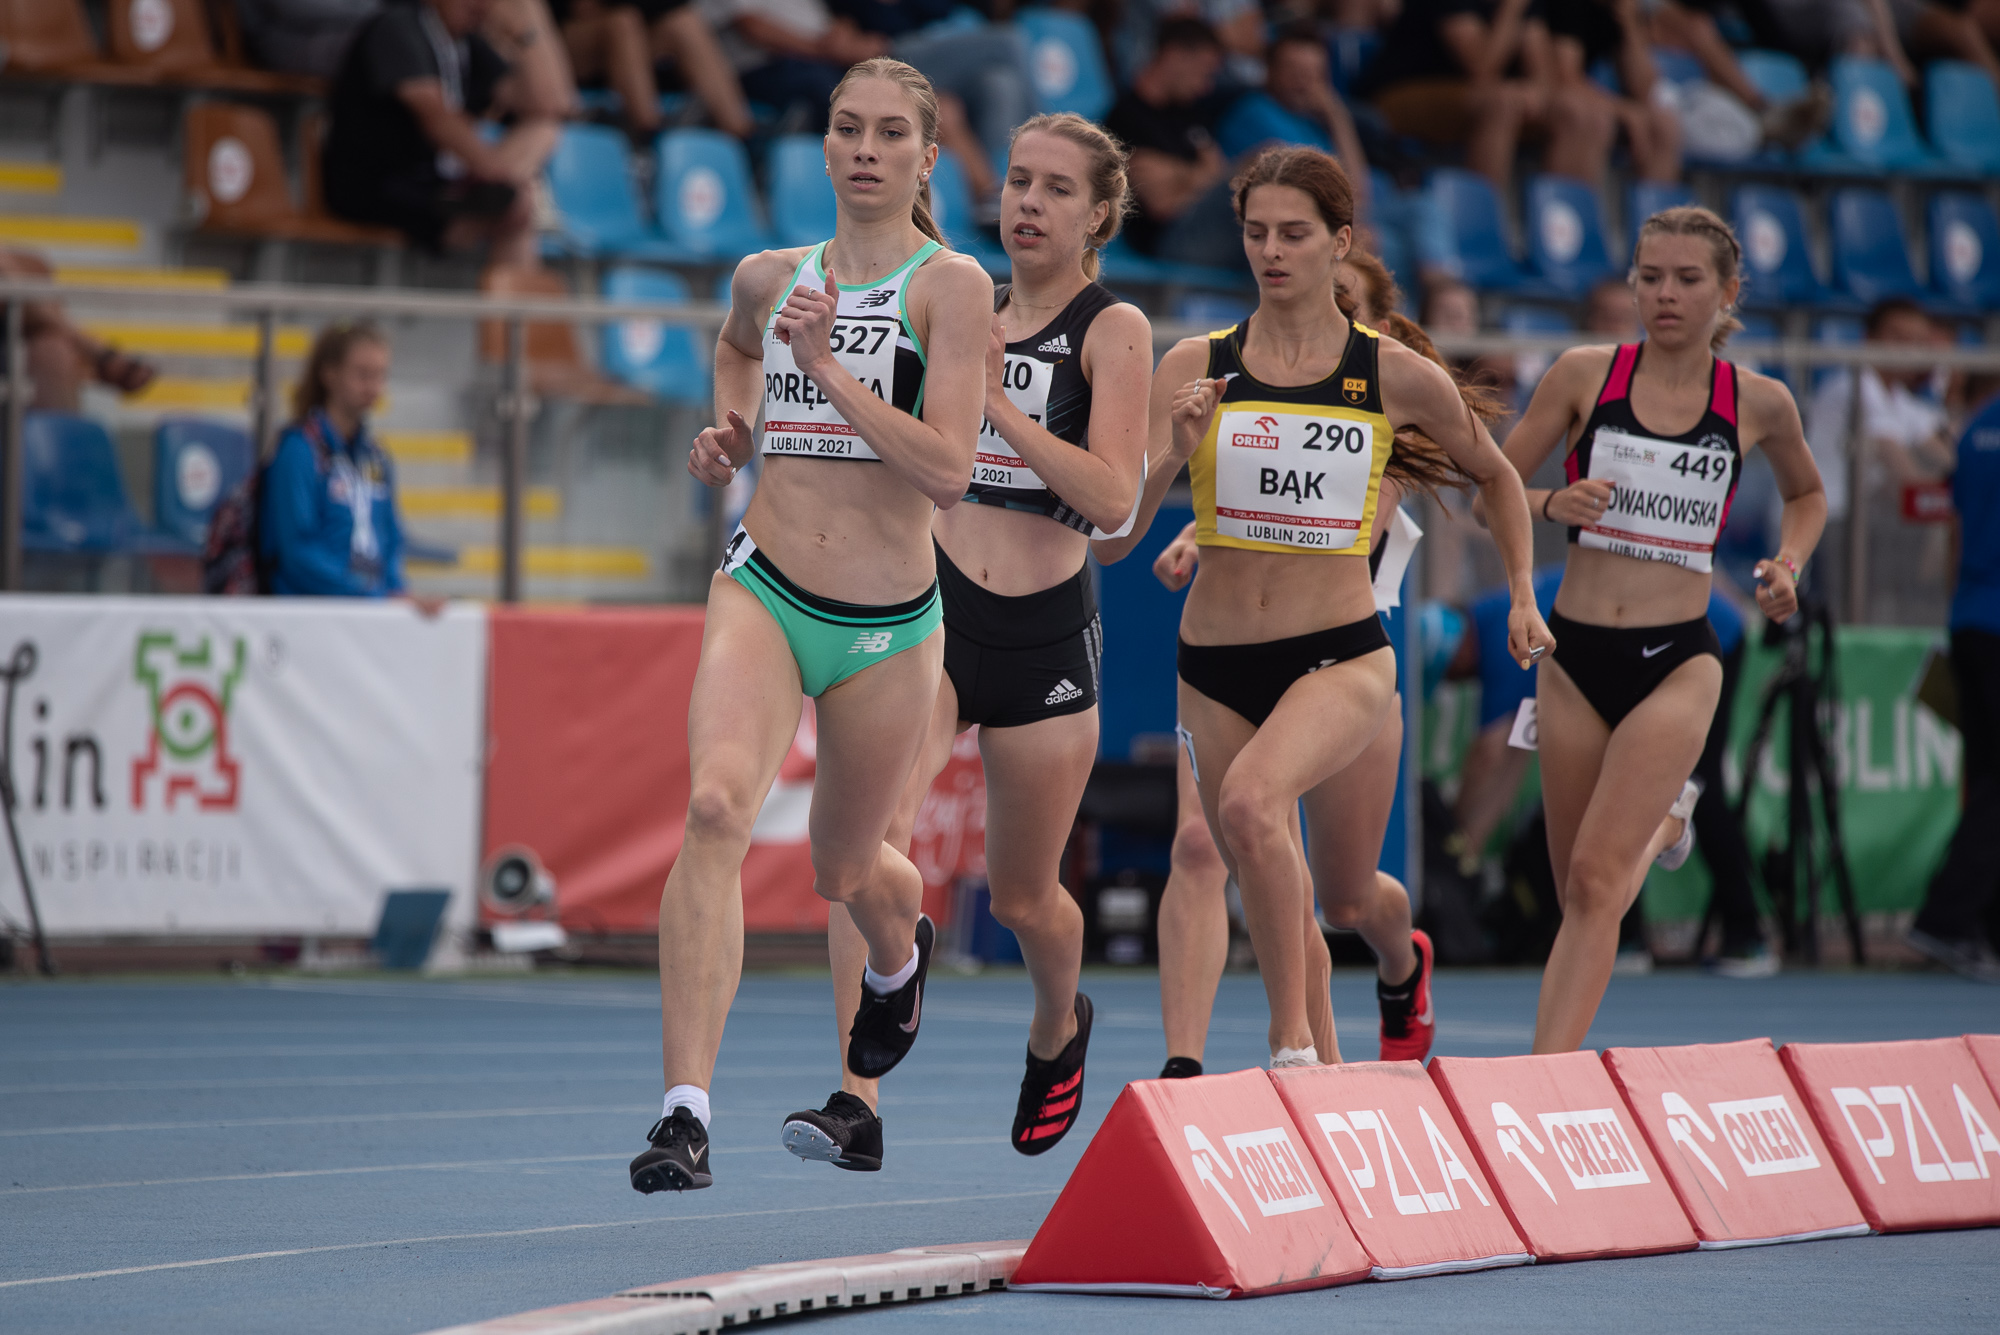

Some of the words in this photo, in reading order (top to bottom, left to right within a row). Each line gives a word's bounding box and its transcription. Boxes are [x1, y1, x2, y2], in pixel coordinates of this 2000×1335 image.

[829, 325, 890, 355] 527
[1038, 342, 1071, 355] adidas
[781, 424, 833, 432] MISTRZOSTWA
[1234, 435, 1277, 448] ORLEN
[1302, 422, 1364, 454] 290
[771, 437, 813, 452] LUBLIN
[817, 439, 852, 454] 2021
[981, 468, 1012, 484] 2021
[1670, 452, 1727, 483] 449
[1260, 467, 1326, 505] BĄK
[1256, 514, 1313, 525] MISTRZOSTWA
[1606, 486, 1717, 528] OWAKOWSKA
[1247, 525, 1293, 542] LUBLIN
[1297, 531, 1330, 545] 2021
[1045, 688, 1083, 705] adidas
[1722, 1105, 1810, 1166] ORLEN
[1831, 1083, 2000, 1184] PZLA
[1315, 1105, 1490, 1219] PZLA
[1551, 1119, 1640, 1179] ORLEN
[1236, 1140, 1314, 1204] ORLEN
